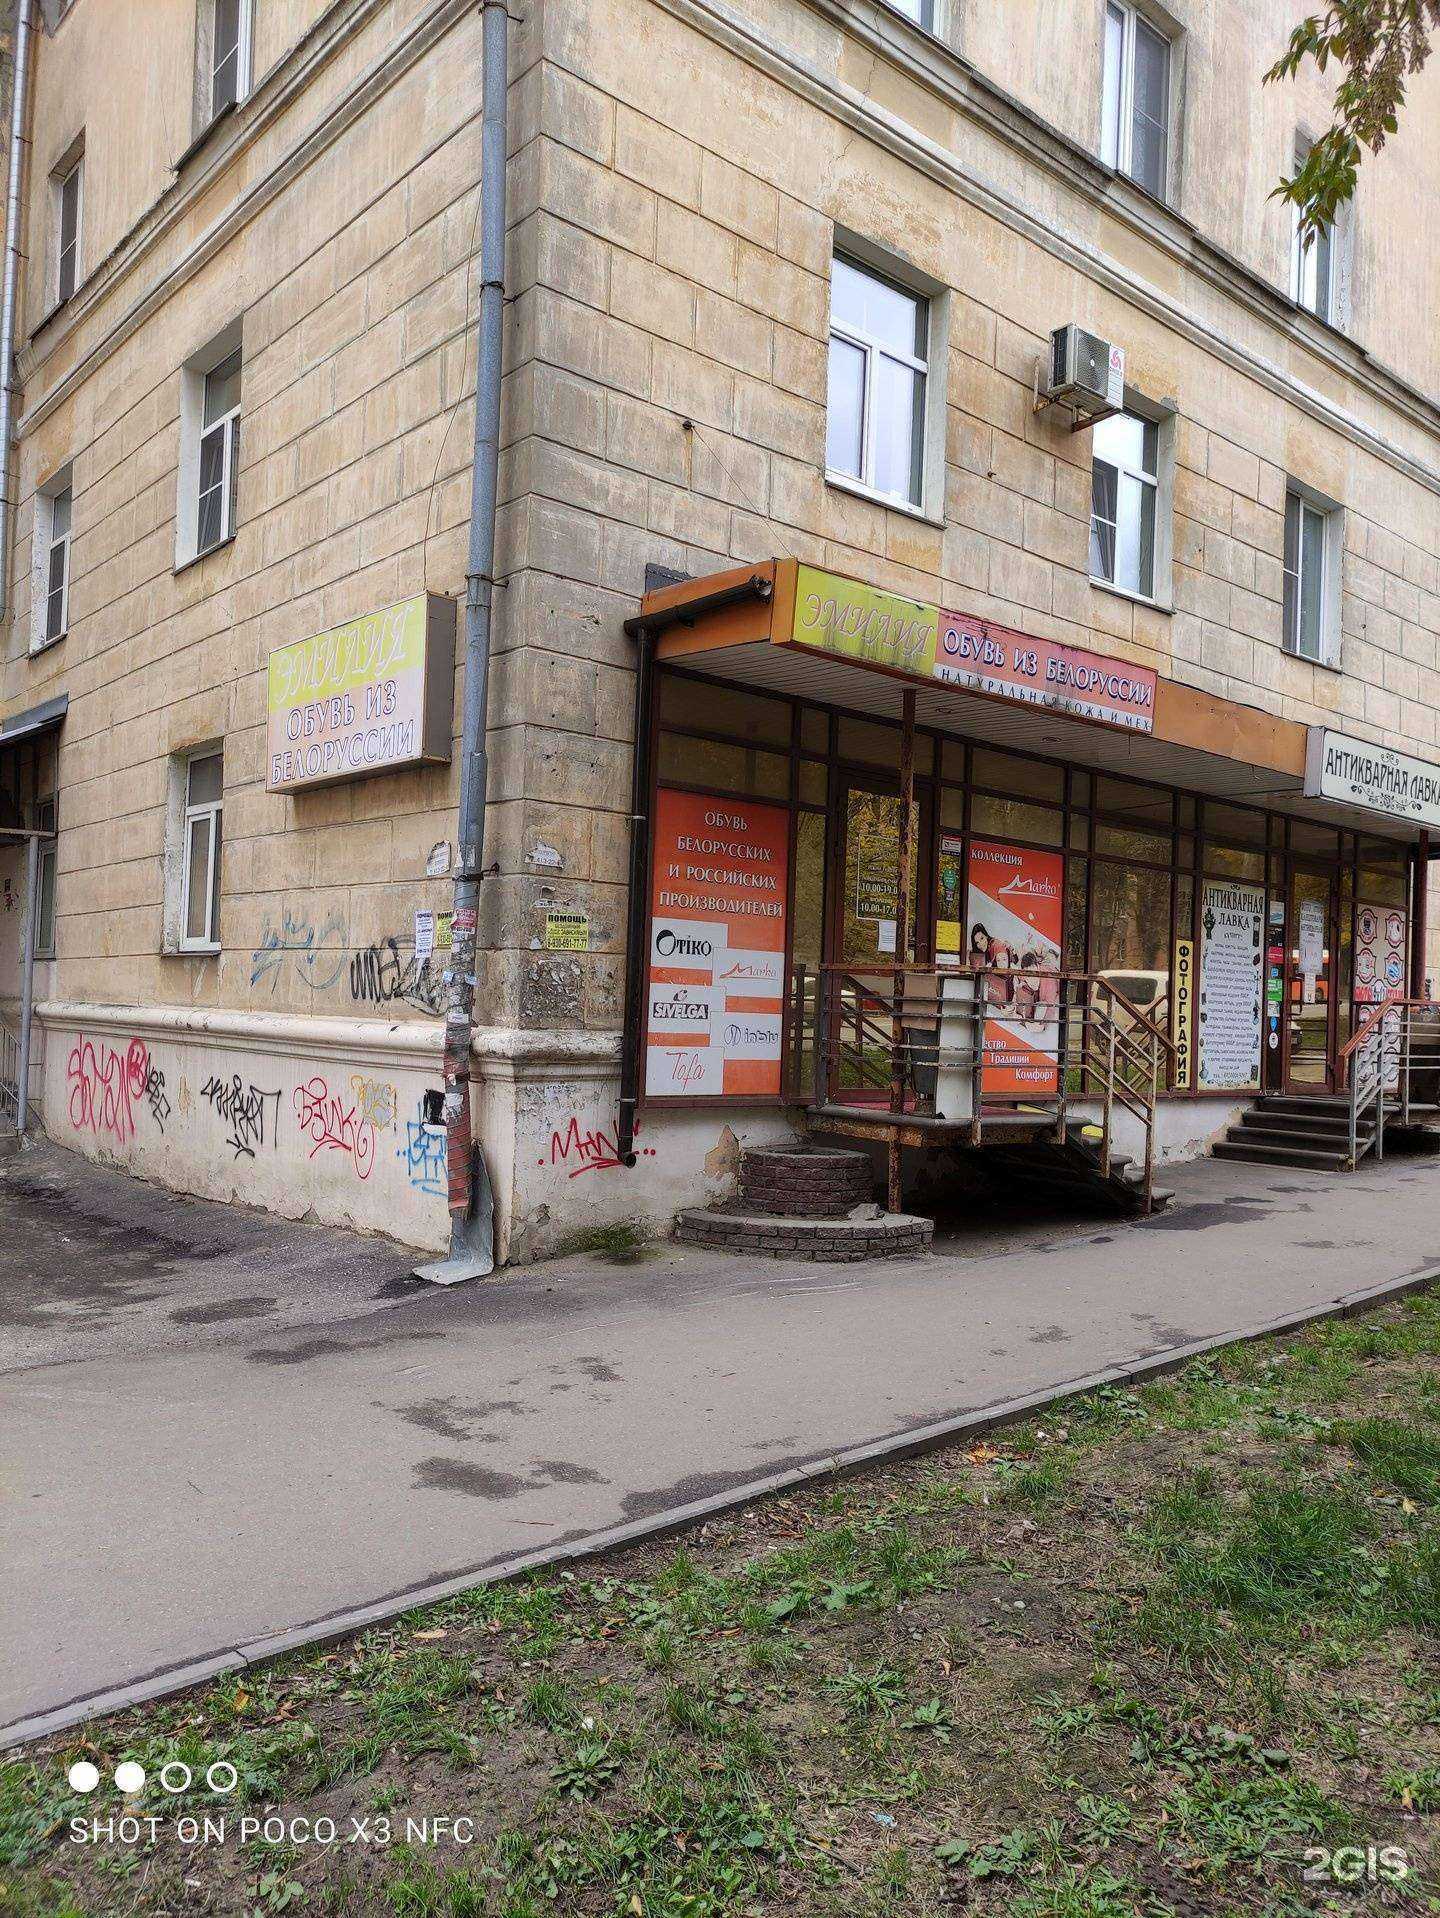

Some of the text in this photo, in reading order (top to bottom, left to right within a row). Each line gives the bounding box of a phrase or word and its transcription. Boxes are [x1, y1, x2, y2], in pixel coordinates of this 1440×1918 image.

[802, 593, 935, 658] ЭМИЛИЯ
[943, 628, 1153, 707] ОБУВЬ ИЗ БЕЛОРУССИИ
[286, 679, 397, 741] ОБУВЬ ИЗ
[941, 668, 1151, 731] НАТУРАЛЬНАЯ КОЖА И МЕХ
[271, 719, 415, 784] БЕЛОРУССИИ
[1325, 747, 1409, 796] АНТИКВАРНАЯ
[704, 811, 749, 831] ОБУВЬ
[677, 835, 772, 861] БЕЛОРУССКИХ
[668, 864, 777, 890] И РОССИЙСКИХ
[659, 890, 783, 918] ПРОИЗВОДИТЕЛЕЙ
[1203, 886, 1264, 914] АНТИКВАРНАЯ
[548, 914, 588, 924] ПОМОЩЬ
[1218, 912, 1251, 931] ЛАВКА
[1178, 944, 1190, 1084] ФОТОГРАФИЯ
[1015, 1067, 1054, 1082] Комфорт
